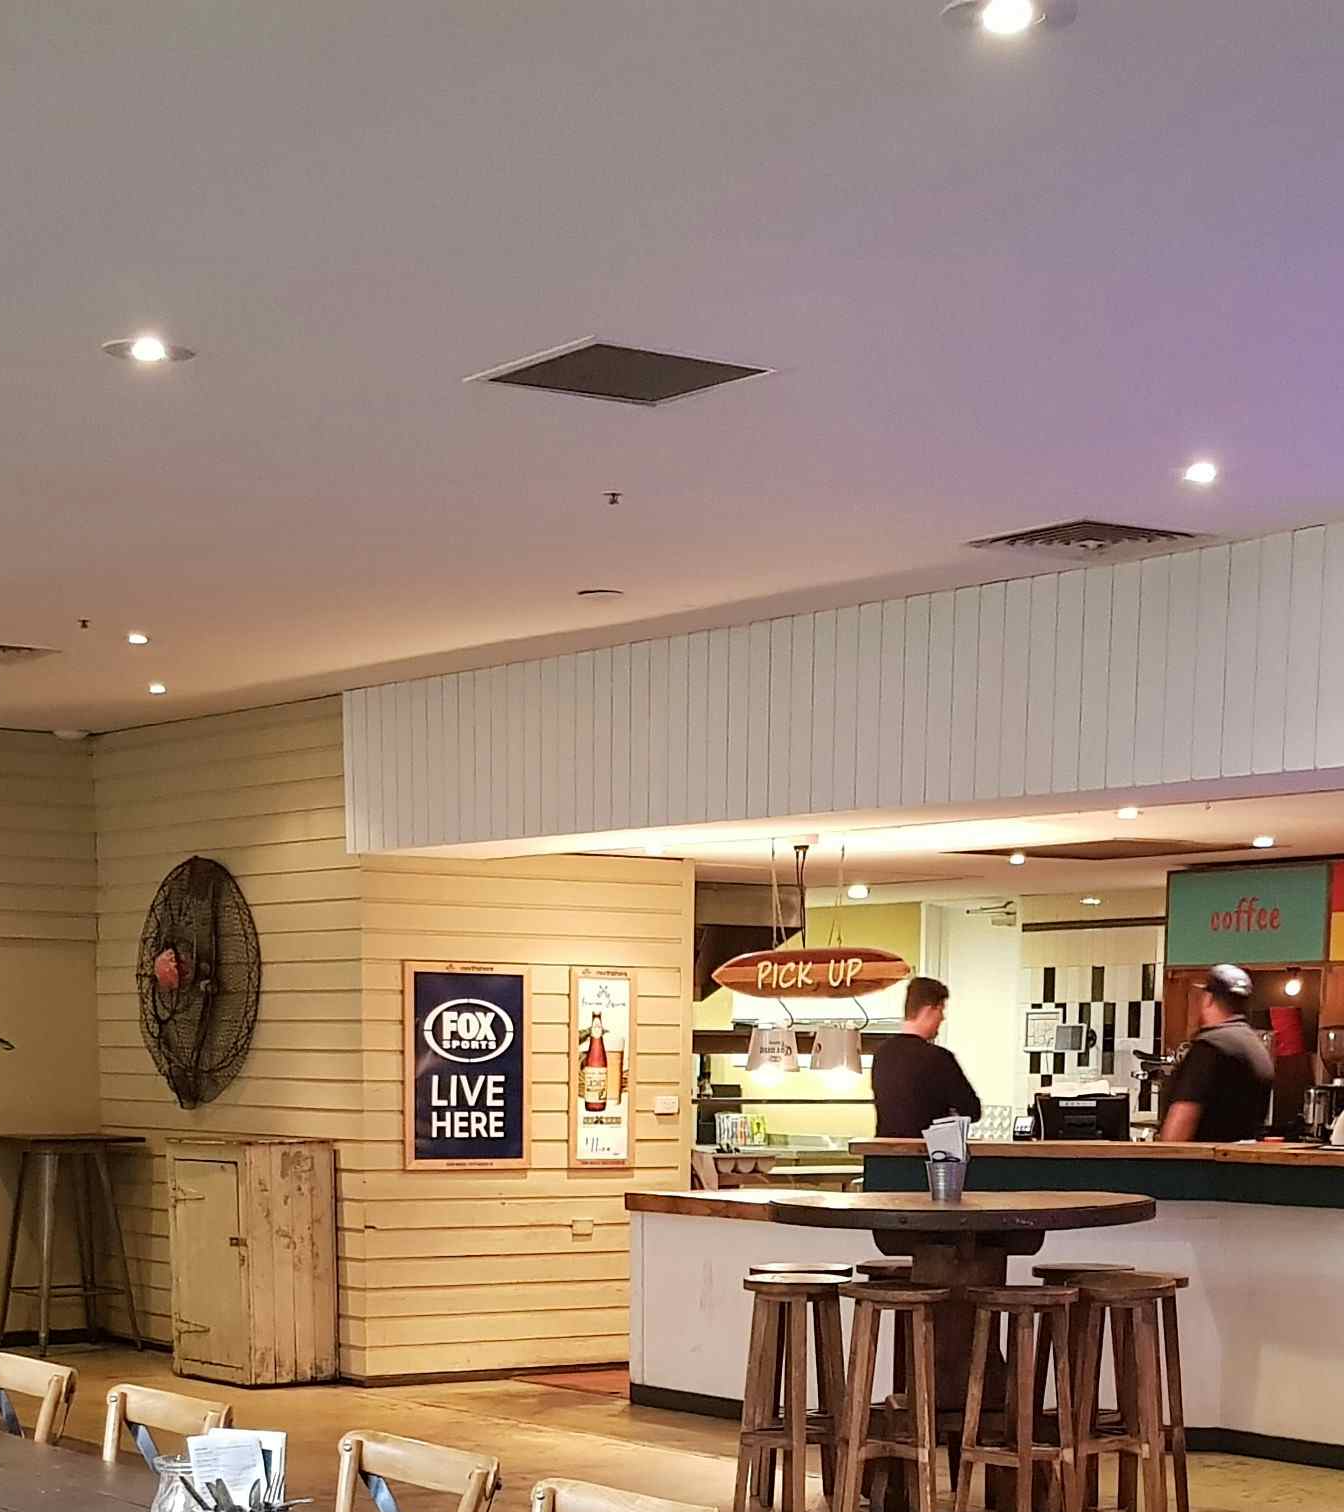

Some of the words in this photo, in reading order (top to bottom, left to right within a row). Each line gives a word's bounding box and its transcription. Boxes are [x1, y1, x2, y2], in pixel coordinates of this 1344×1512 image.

[1210, 896, 1281, 932] coffee
[757, 960, 814, 989] PICK
[828, 957, 863, 987] UP
[442, 1010, 497, 1041] FOX
[442, 1040, 497, 1050] SPORTS
[431, 1074, 505, 1108] LIVE
[431, 1111, 505, 1138] HERE
